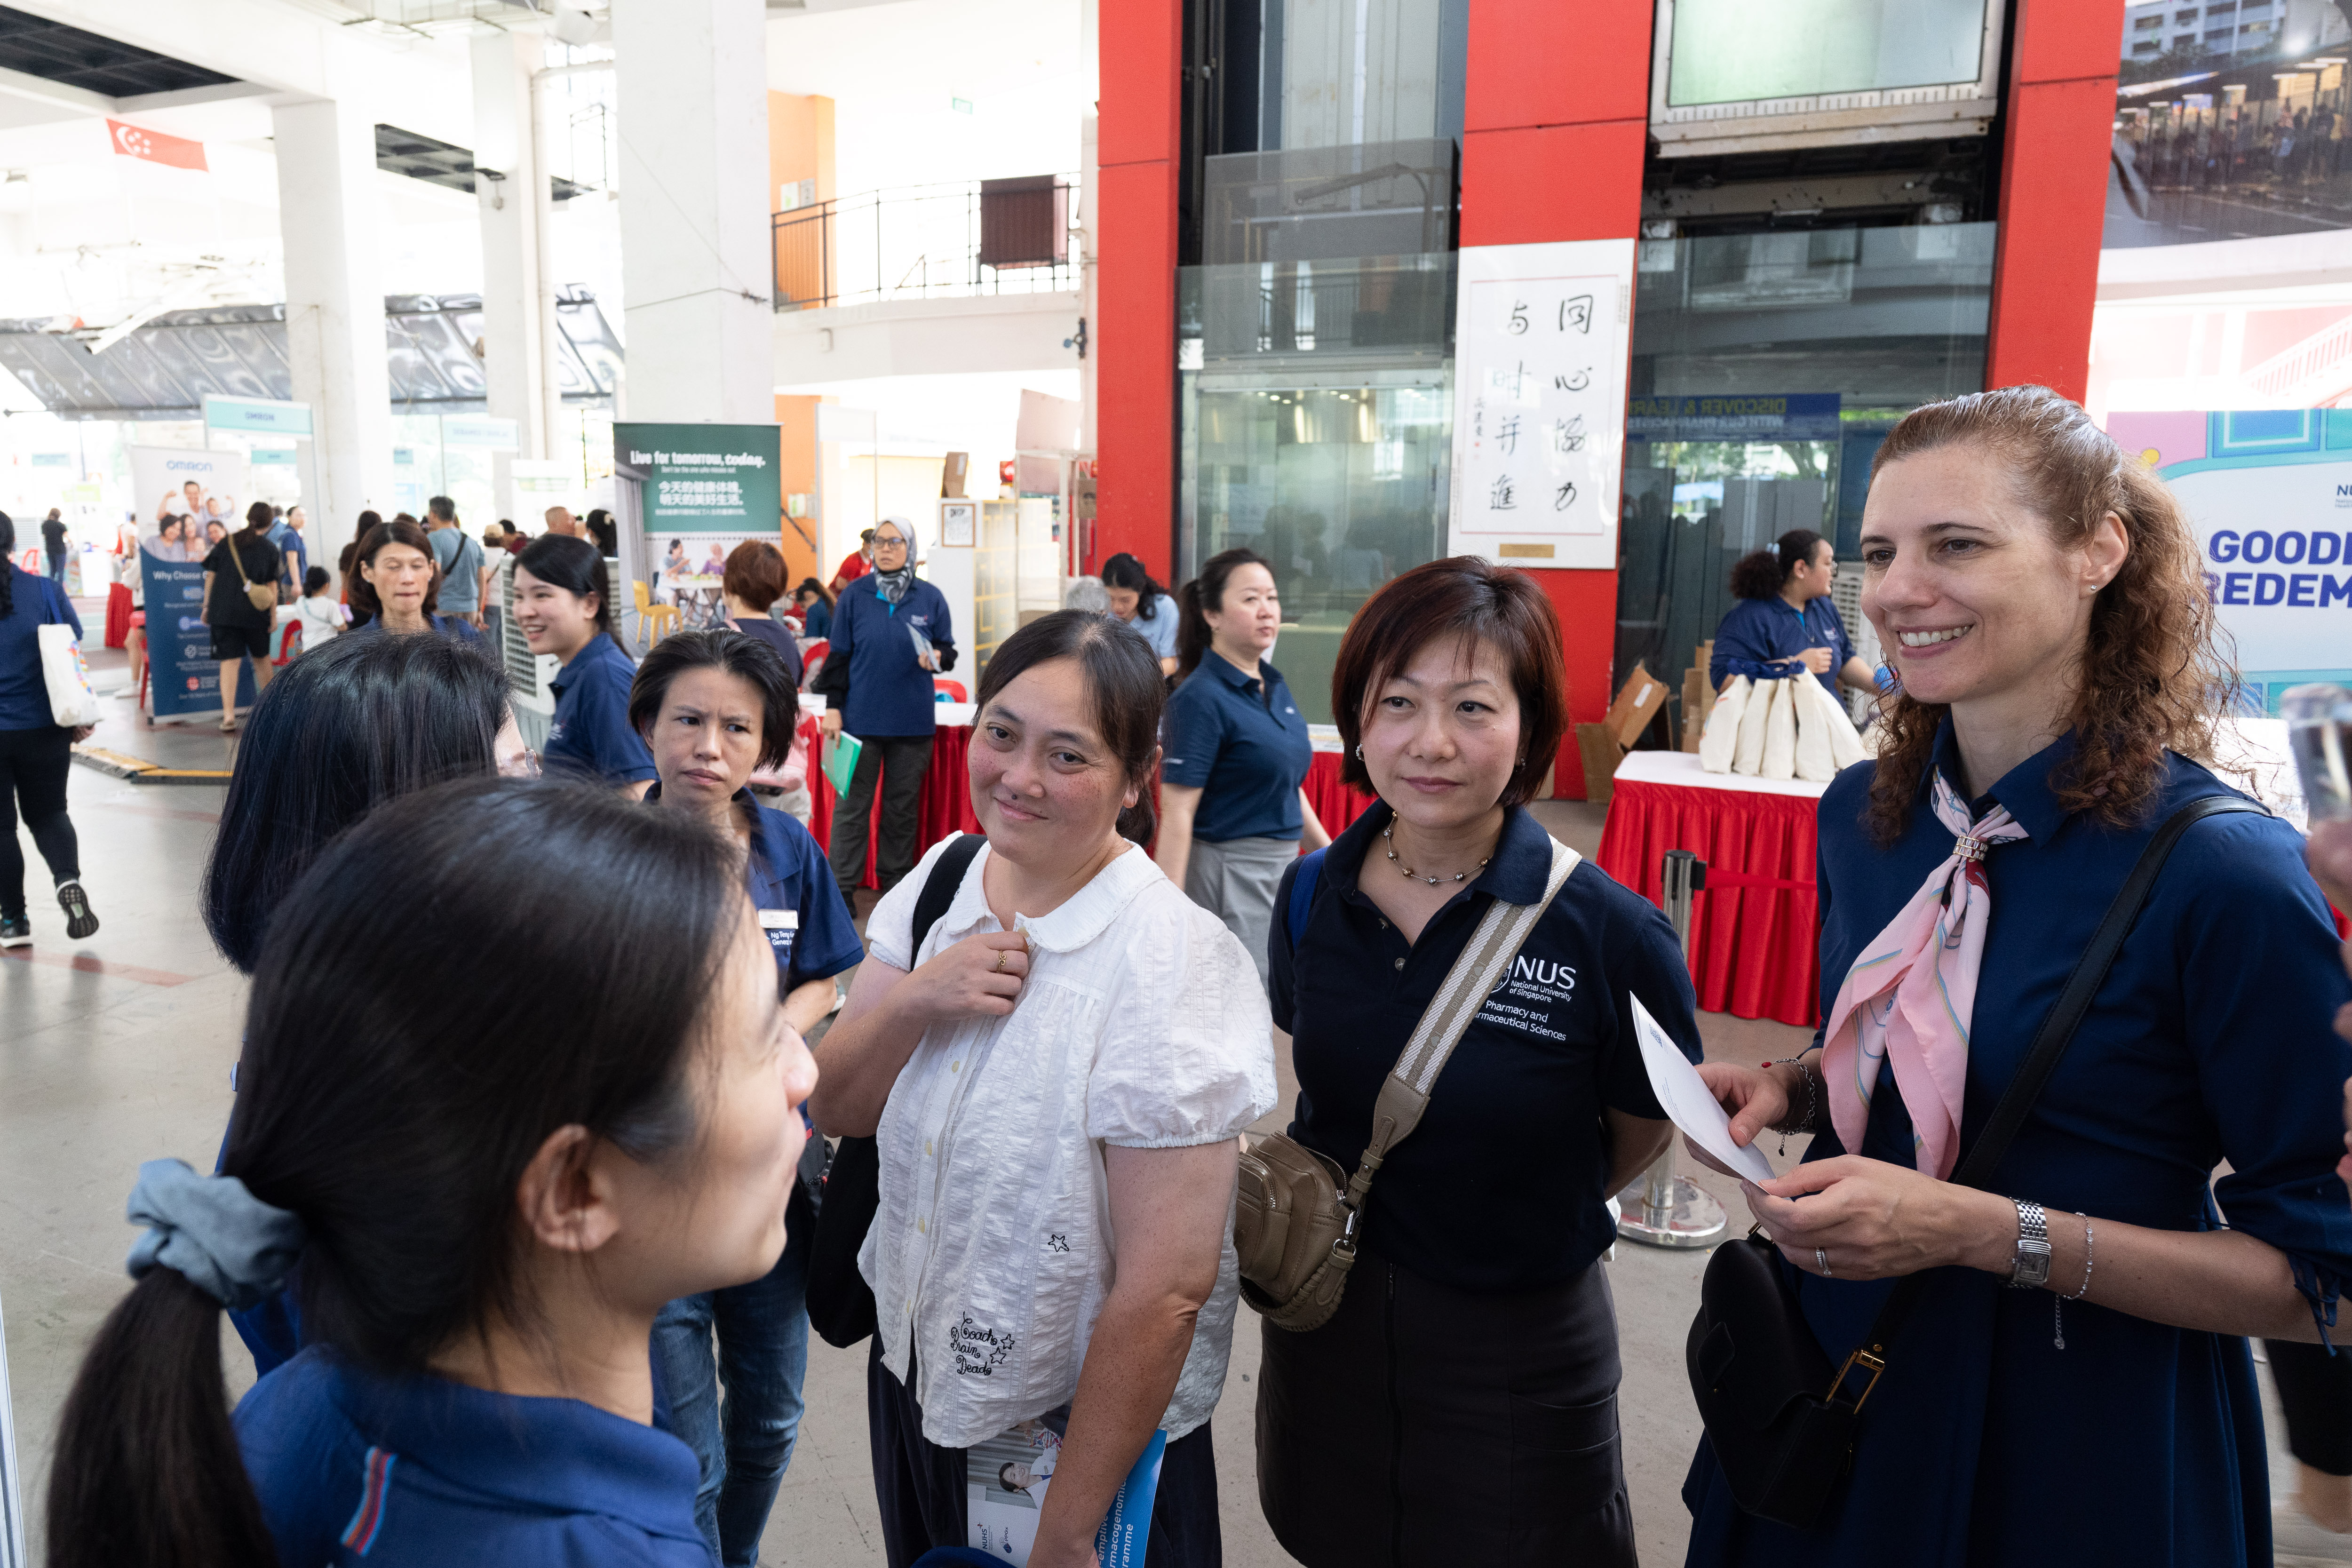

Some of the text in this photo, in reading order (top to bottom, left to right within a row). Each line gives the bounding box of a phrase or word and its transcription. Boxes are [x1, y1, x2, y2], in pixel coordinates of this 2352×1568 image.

[630, 450, 766, 468] Live for tomorrow, today.
[153, 571, 172, 582] Why
[1514, 955, 1576, 990] NUS
[1450, 974, 1478, 1011] Desigual
[1511, 980, 1572, 1002] National University
[1518, 989, 1552, 1003] Singapore
[1486, 1000, 1549, 1023] Pharmacy and
[1530, 1023, 1566, 1041] Sciences
[961, 1311, 998, 1345] Coach
[956, 1355, 992, 1376] Dead
[1109, 1479, 1127, 1568] rmacogenomic
[1121, 1524, 1134, 1568] ramme
